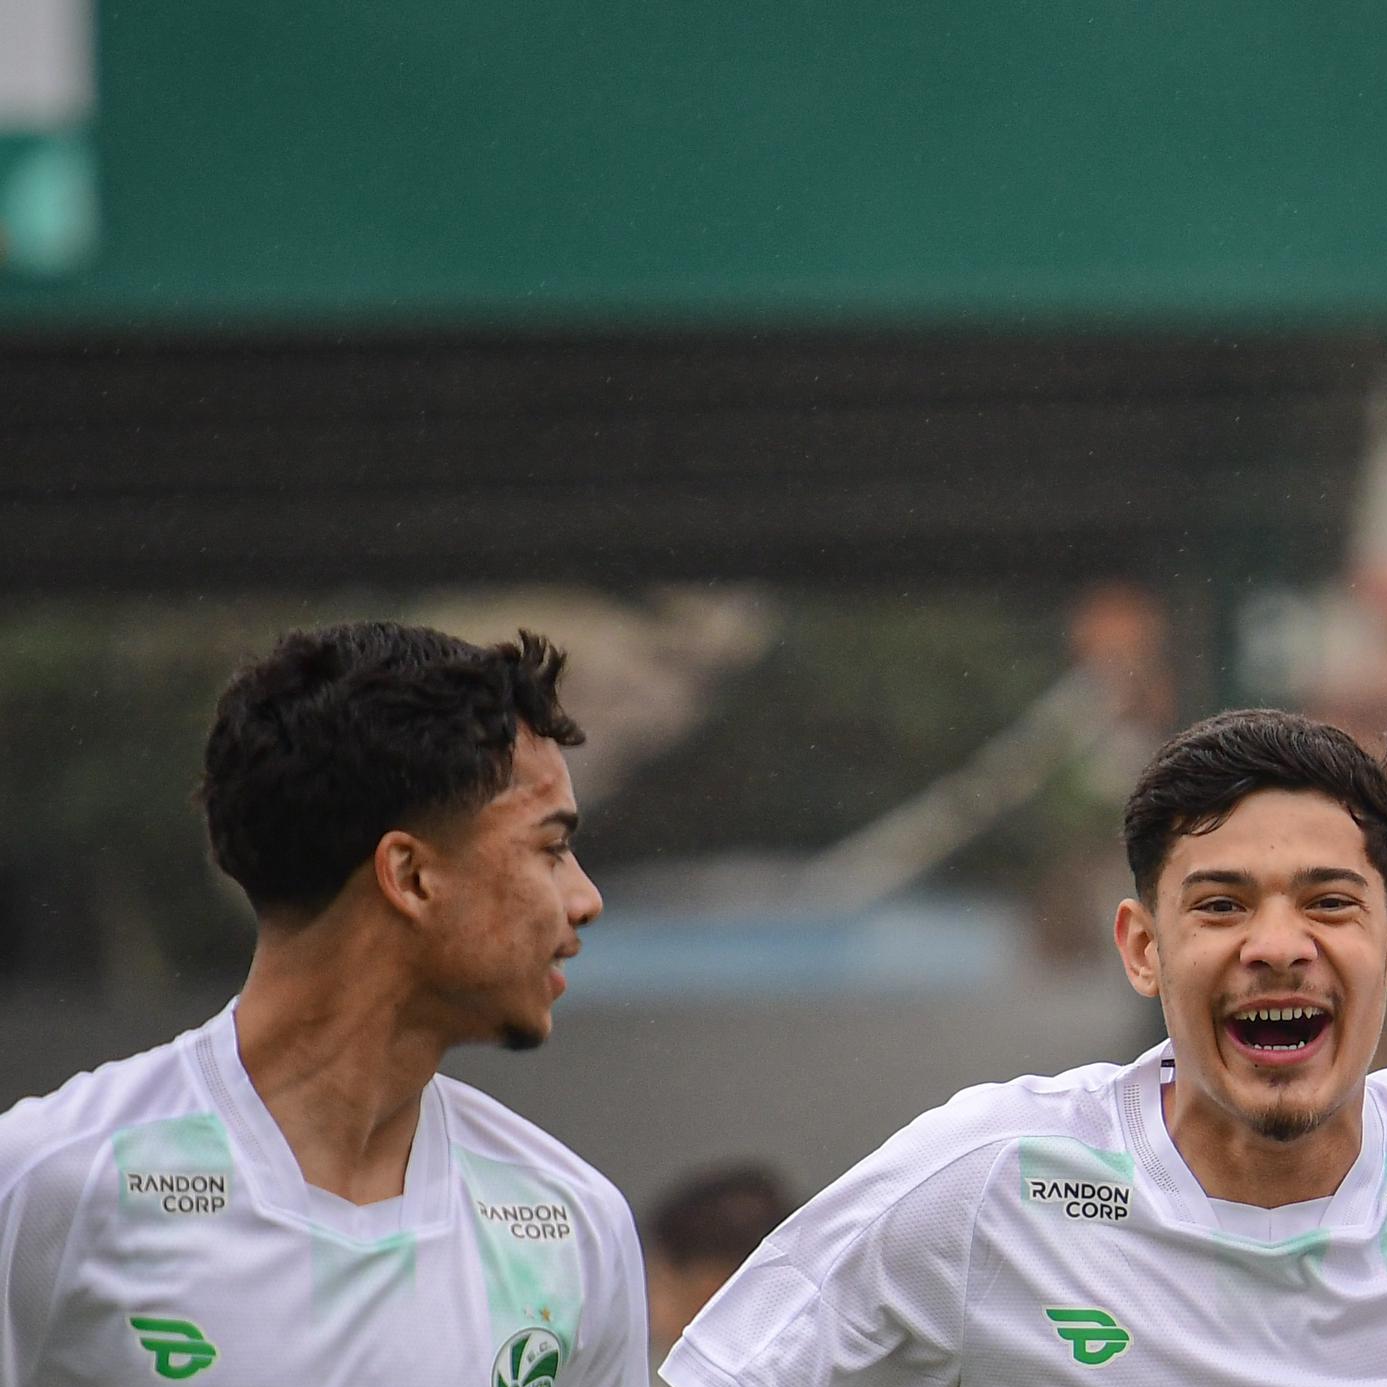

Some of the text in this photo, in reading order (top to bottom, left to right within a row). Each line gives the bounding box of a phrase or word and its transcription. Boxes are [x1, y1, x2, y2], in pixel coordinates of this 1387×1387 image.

[128, 1173, 225, 1193] RANDON
[1031, 1181, 1130, 1204] RANDON
[163, 1195, 225, 1214] CORP
[1066, 1201, 1129, 1221] CORP
[511, 1223, 570, 1240] CORP
